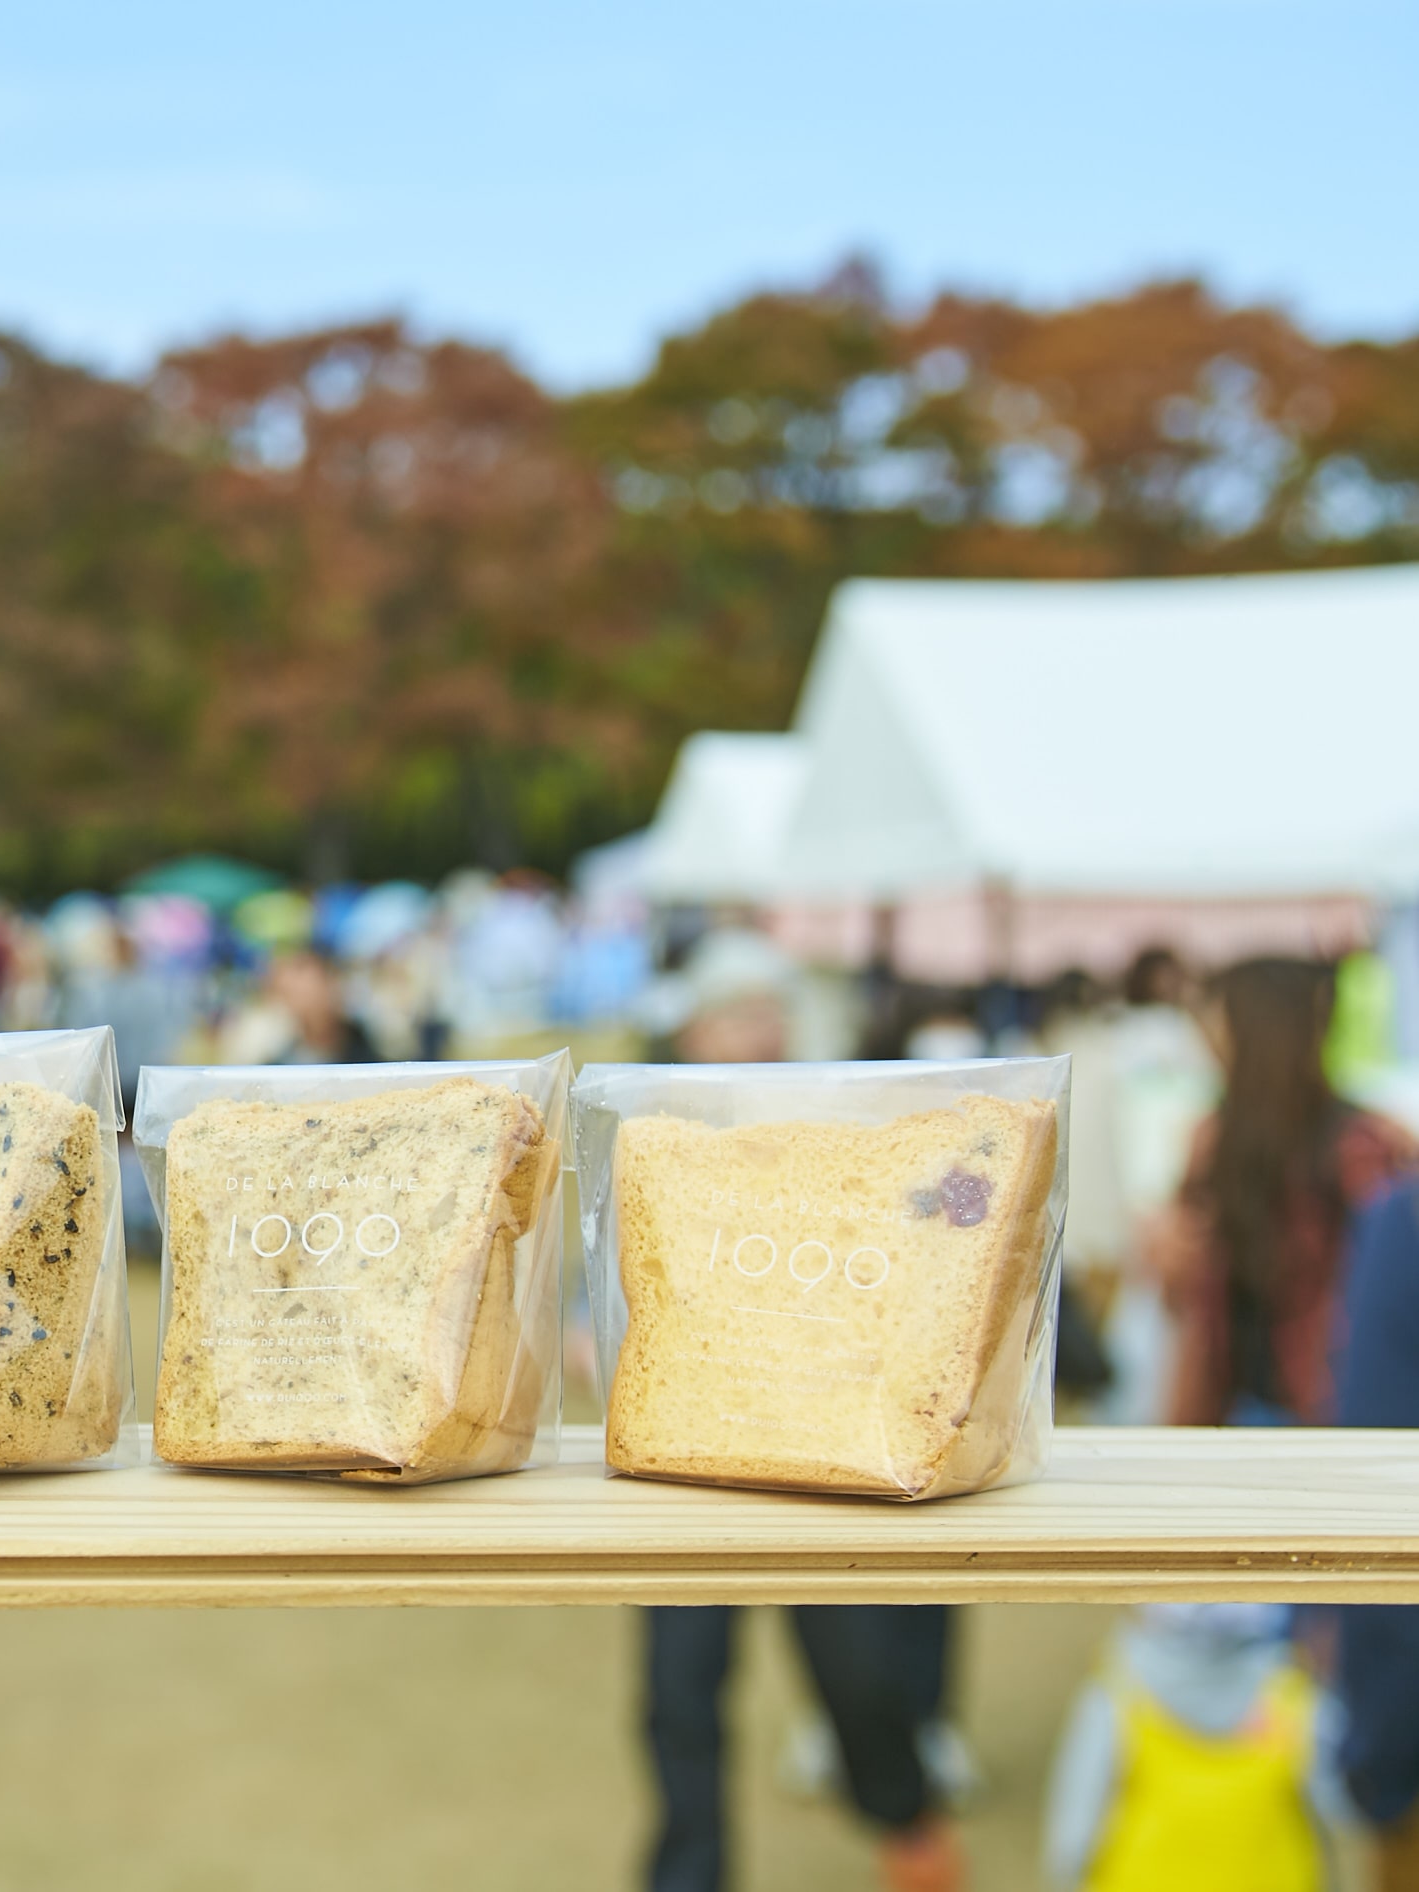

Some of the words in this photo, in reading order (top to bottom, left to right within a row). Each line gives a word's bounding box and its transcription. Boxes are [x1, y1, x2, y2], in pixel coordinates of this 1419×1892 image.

[226, 1177, 254, 1191] DE
[267, 1177, 293, 1190] LA
[308, 1176, 419, 1191] BLANCHE
[711, 1190, 739, 1206] DE
[754, 1196, 783, 1211] LA
[799, 1200, 913, 1226] BLANCHE
[250, 1319, 265, 1328] UN
[201, 1338, 213, 1347] DE
[261, 1338, 274, 1347] DE
